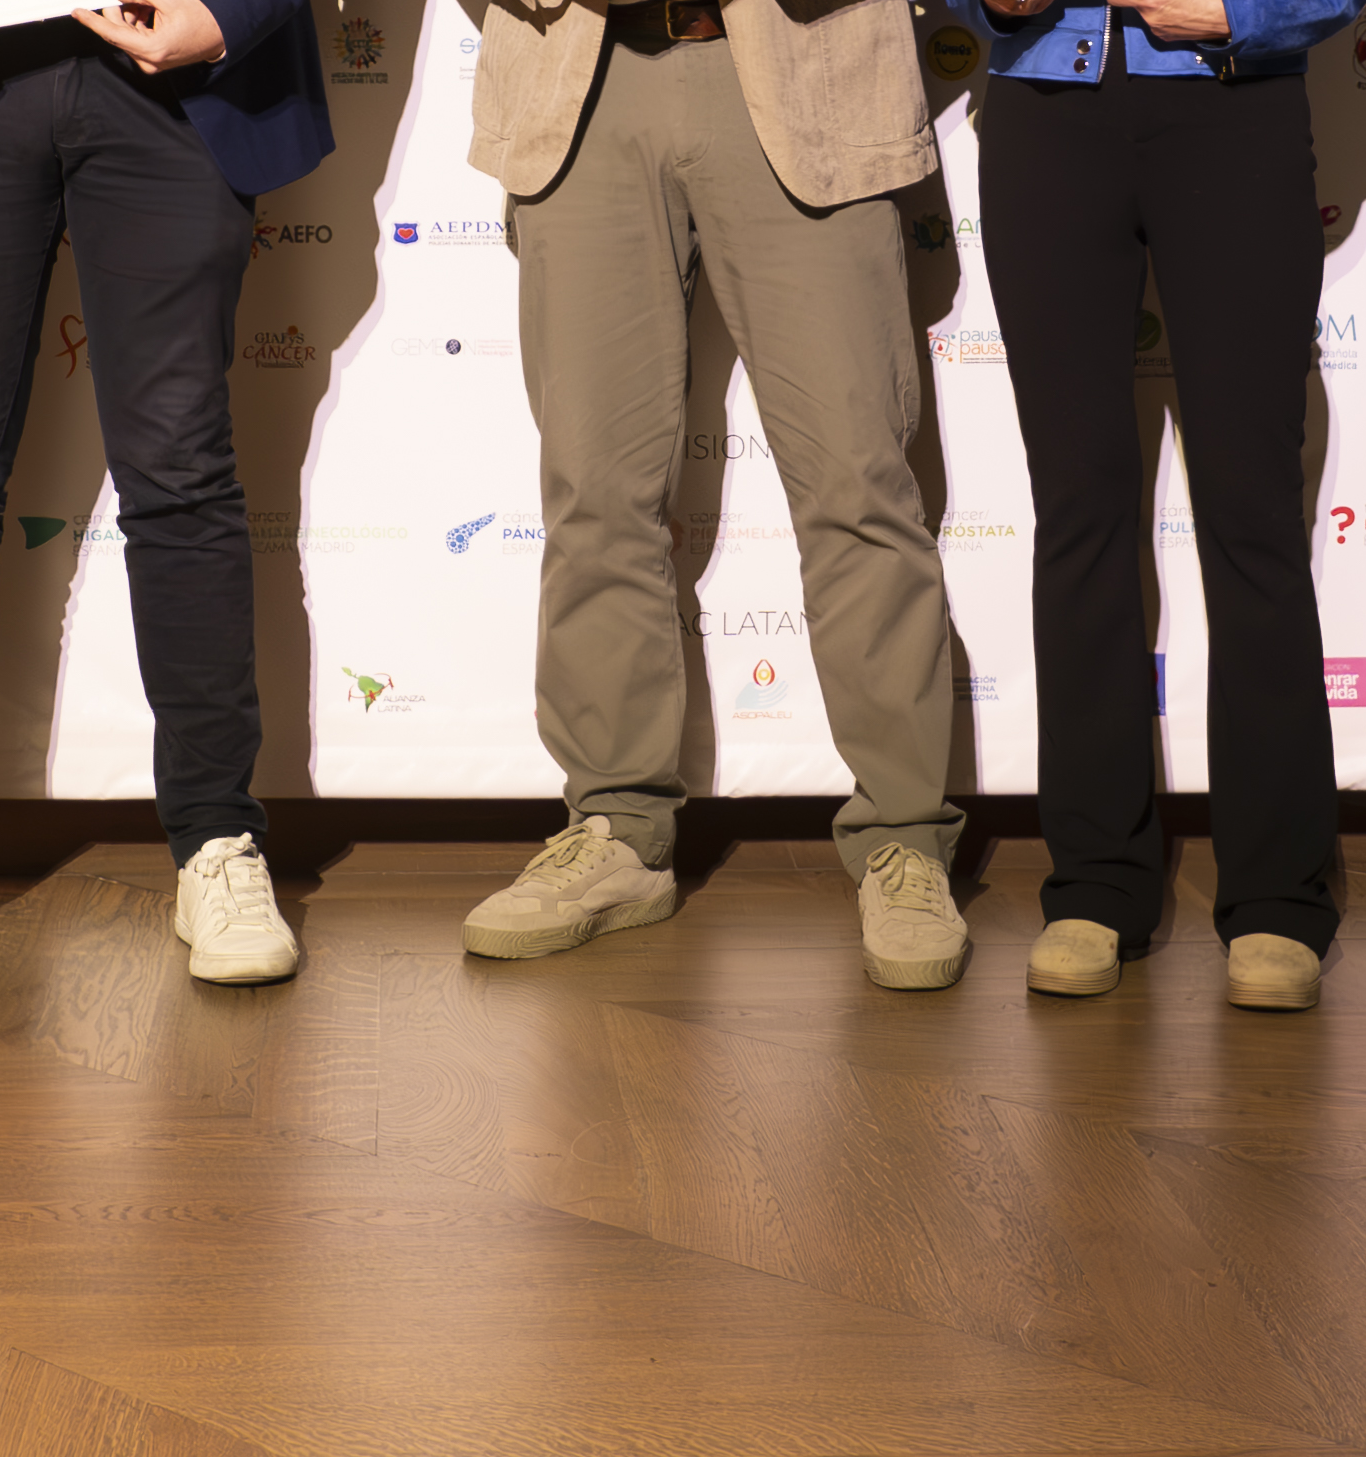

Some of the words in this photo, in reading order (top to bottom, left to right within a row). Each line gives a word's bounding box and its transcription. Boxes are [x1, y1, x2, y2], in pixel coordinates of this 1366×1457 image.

[278, 224, 333, 244] AEFO
[685, 434, 771, 460] ISION
[502, 509, 540, 524] cánc
[942, 507, 990, 522] áncer/
[73, 525, 126, 542] HÍGAD
[503, 524, 546, 540] PÁNC
[942, 523, 1016, 538] RÓSTATA
[502, 541, 543, 555] ESPAÑ
[940, 539, 984, 553] SPAÑA
[723, 611, 808, 636] LATA
[382, 694, 427, 703] ALIANZA
[377, 704, 413, 713] LATINA
